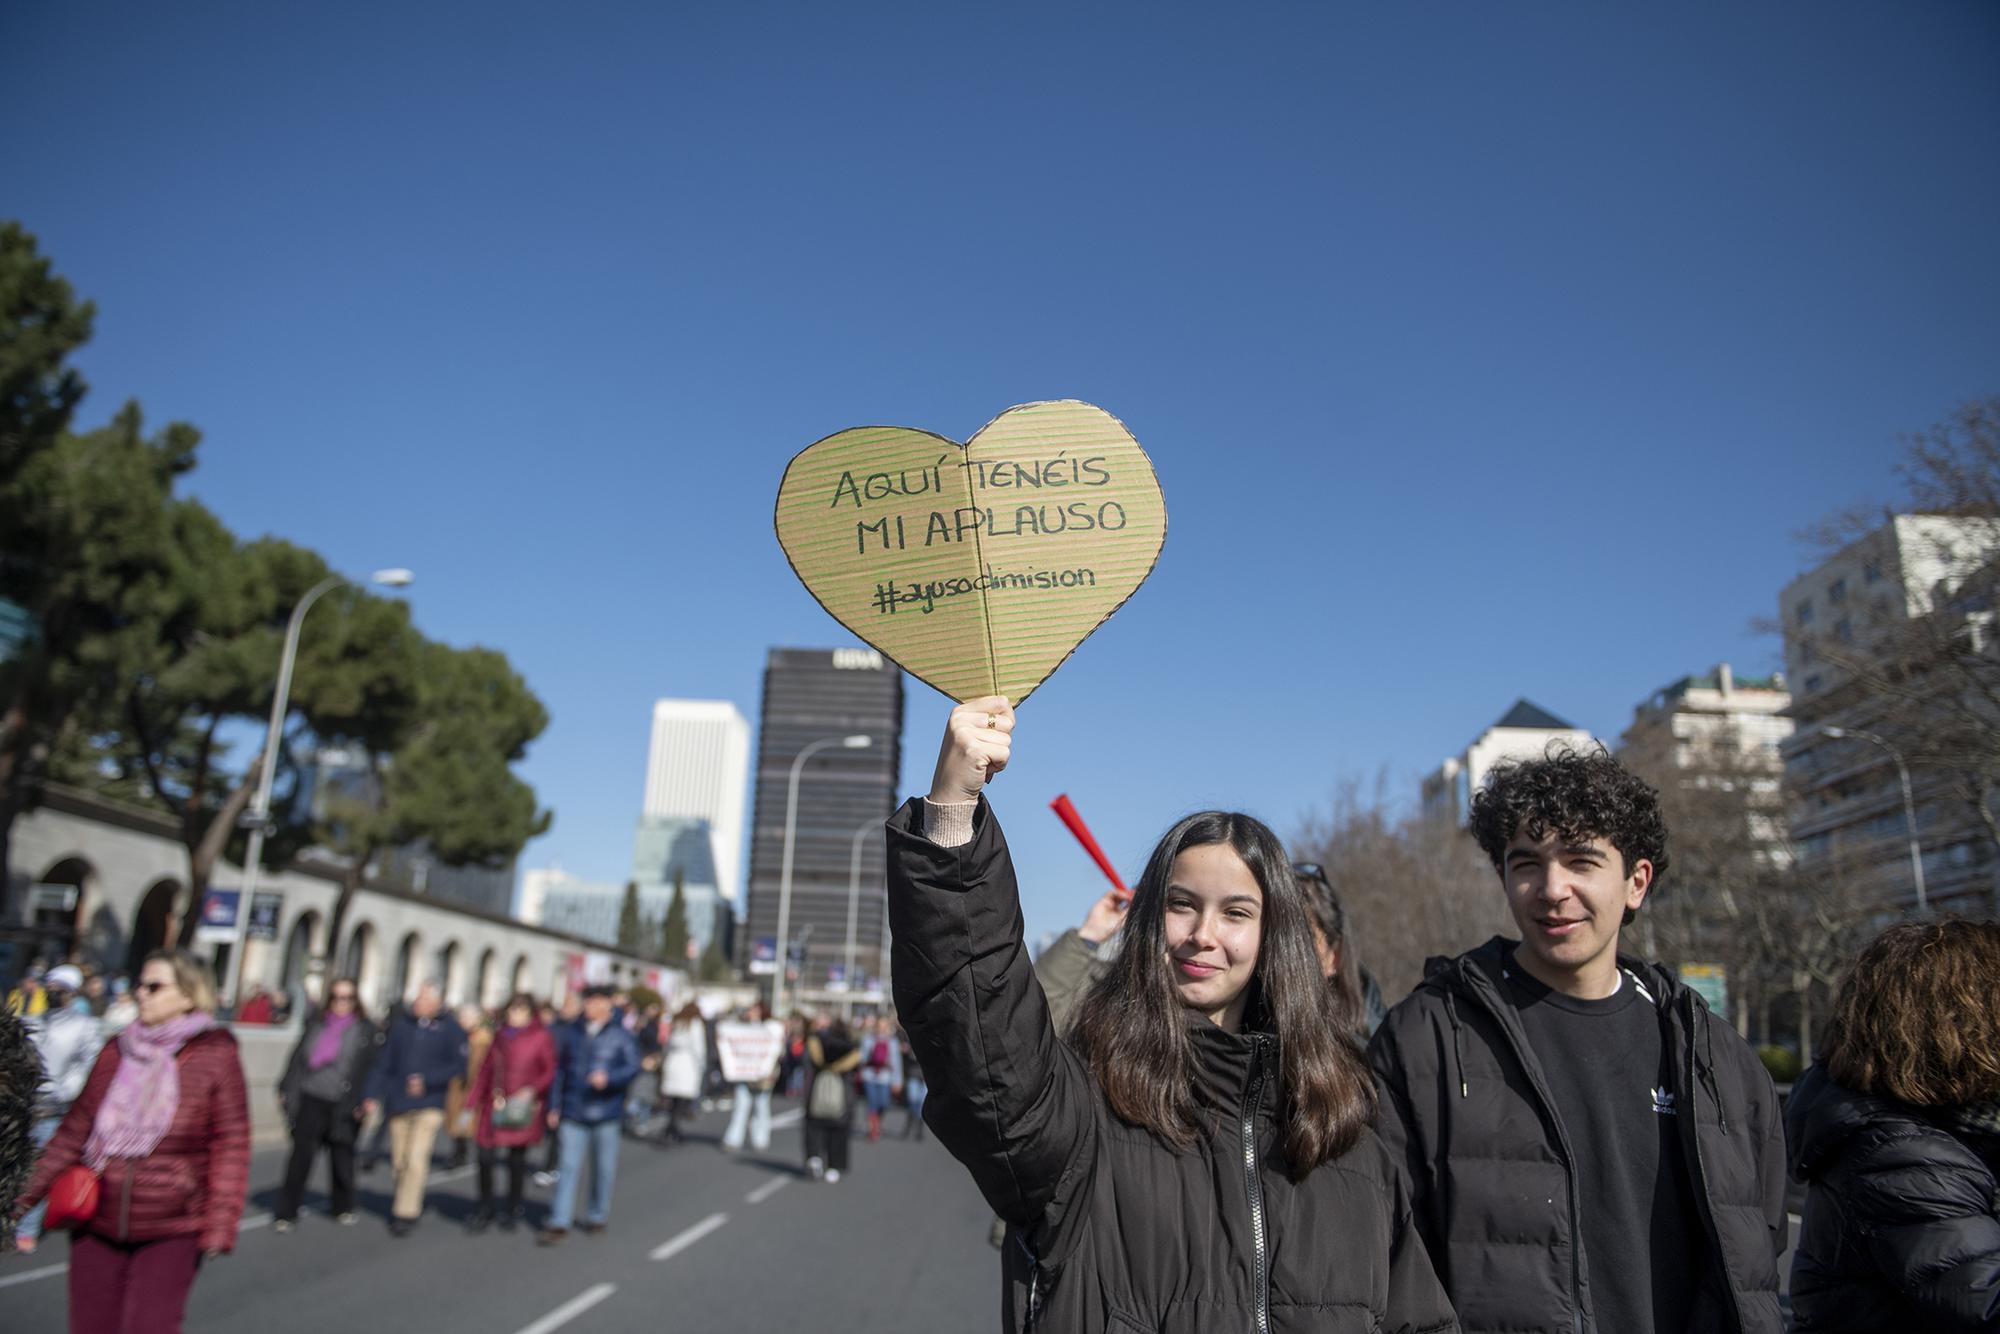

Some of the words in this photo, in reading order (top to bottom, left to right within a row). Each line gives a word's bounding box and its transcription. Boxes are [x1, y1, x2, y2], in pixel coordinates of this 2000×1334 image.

[831, 454, 948, 508] AQUÍ
[959, 450, 1111, 489] TENÉIS
[857, 515, 905, 554] MI
[924, 501, 1127, 546] APLAUSO
[871, 562, 1096, 614] #ayusodimision
